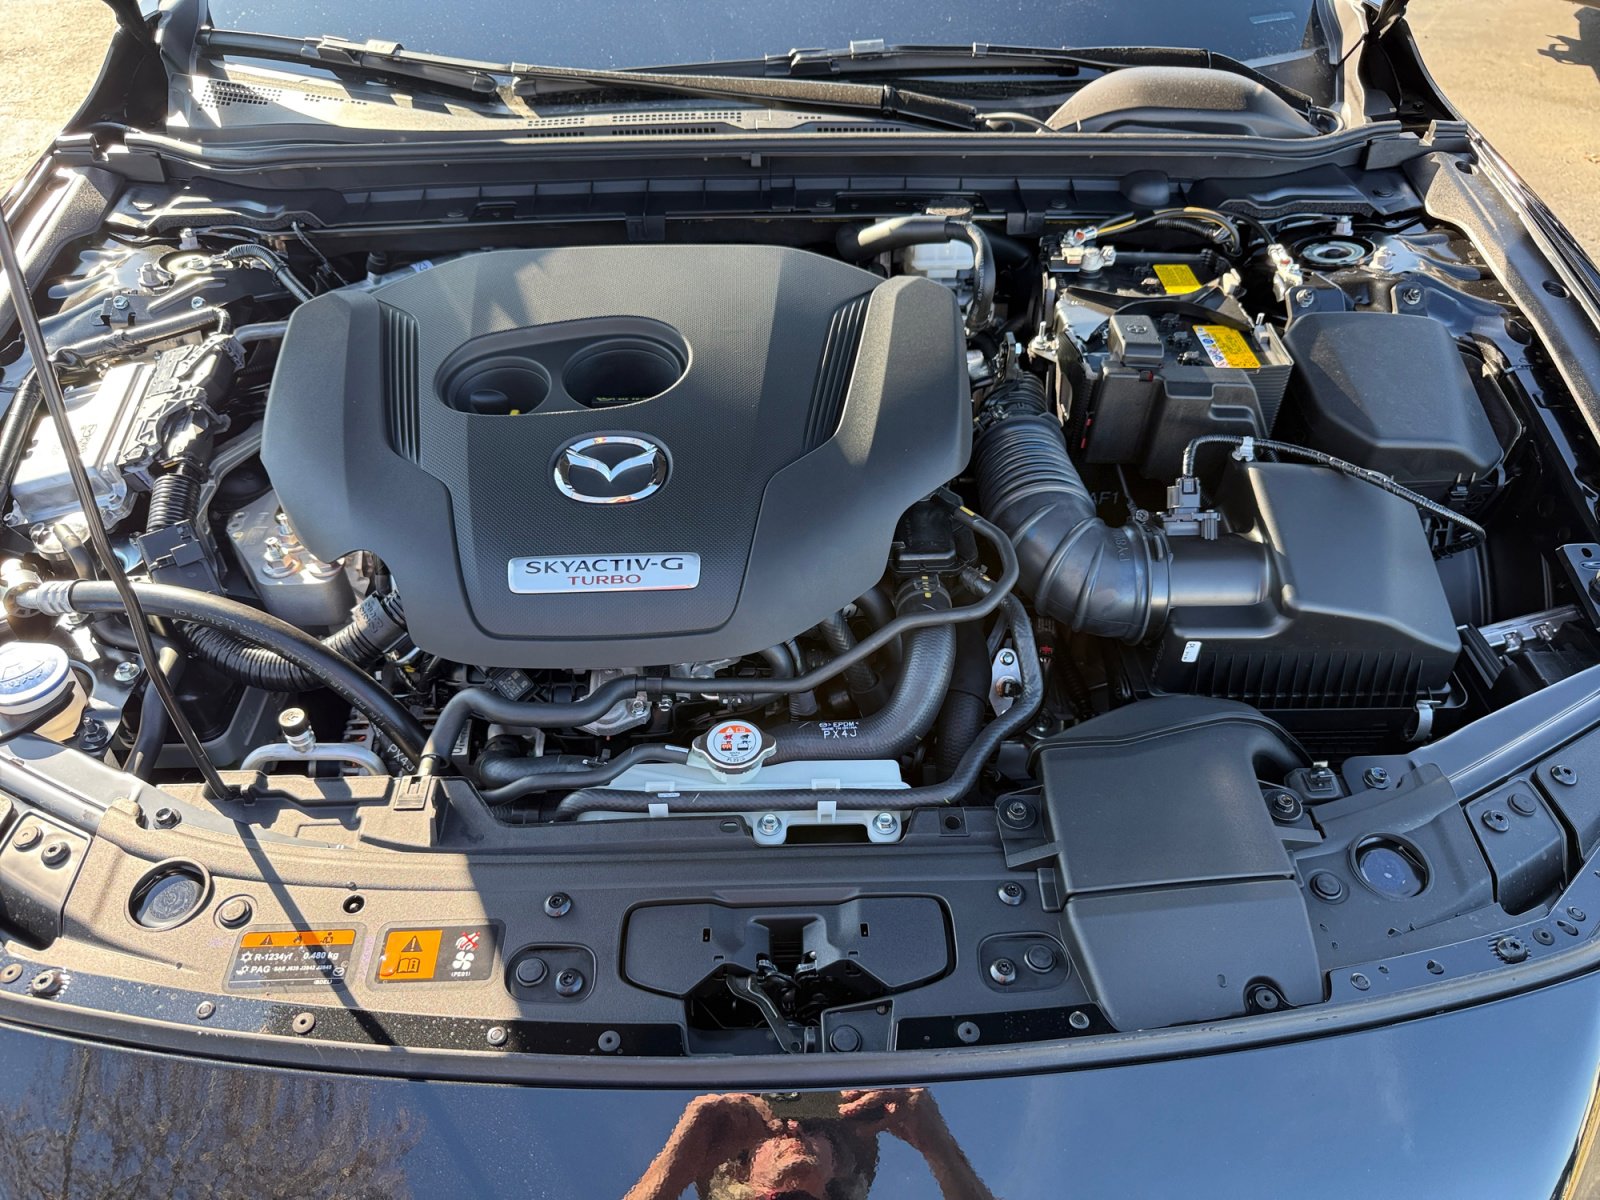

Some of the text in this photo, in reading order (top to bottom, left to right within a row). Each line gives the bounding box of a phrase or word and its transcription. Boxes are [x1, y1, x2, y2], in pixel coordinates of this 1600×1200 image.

[525, 557, 684, 574] SKYACTIV-G
[568, 574, 642, 586] TURBO
[387, 743, 416, 773] PX4J
[327, 951, 340, 960] kg
[250, 965, 271, 973] PAG
